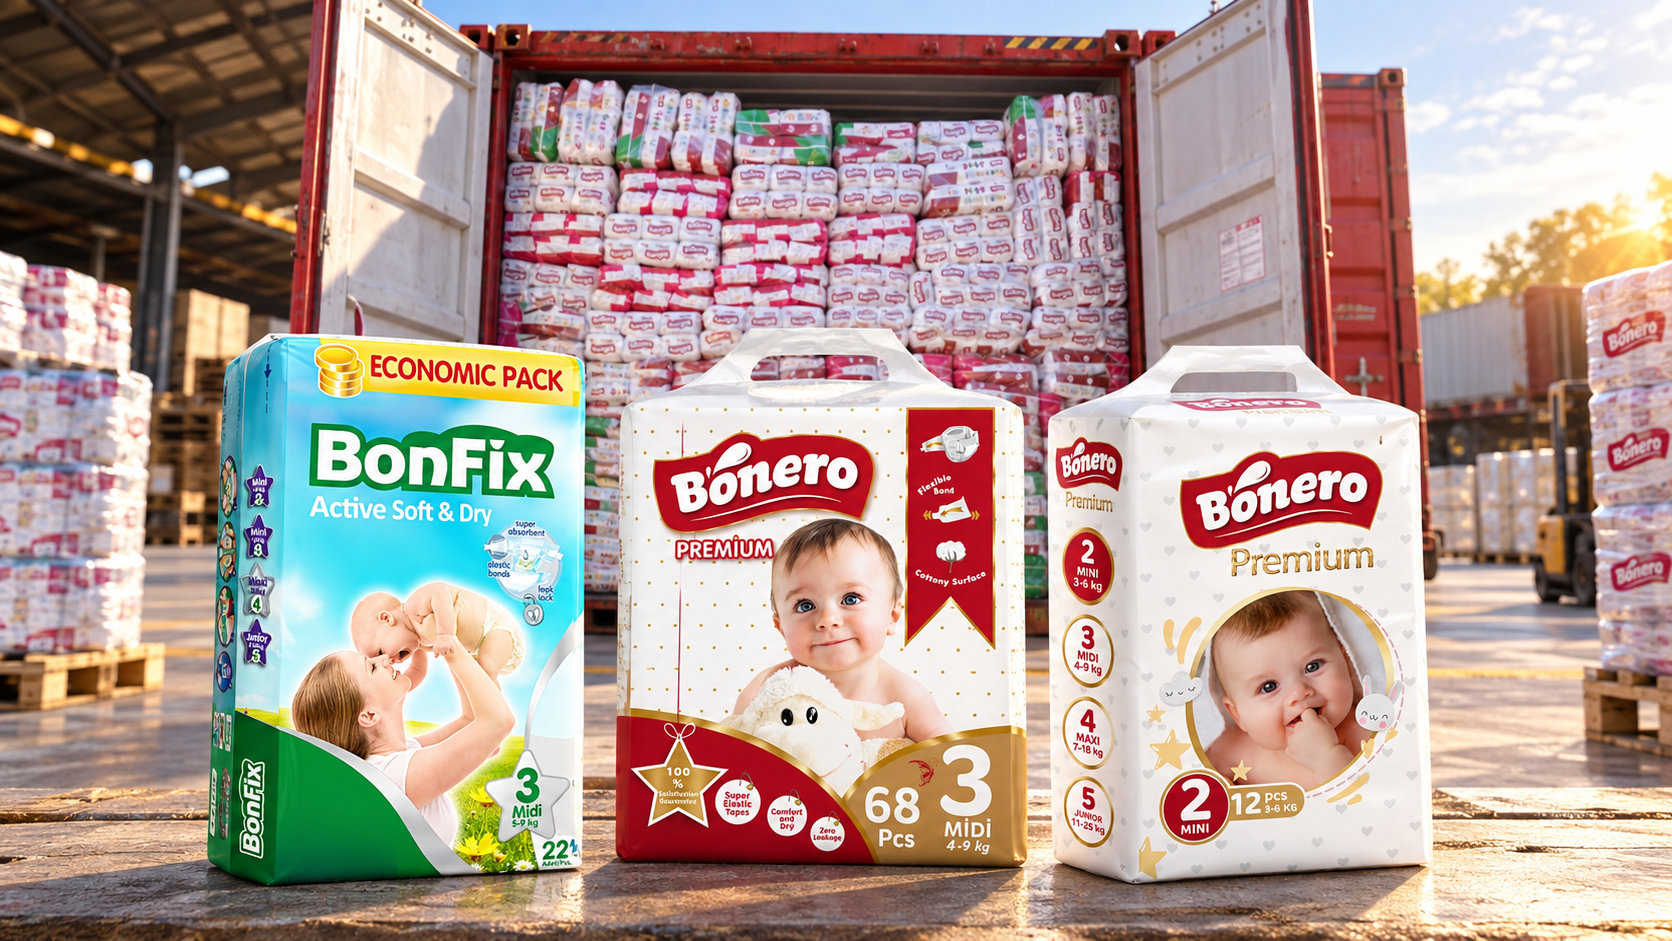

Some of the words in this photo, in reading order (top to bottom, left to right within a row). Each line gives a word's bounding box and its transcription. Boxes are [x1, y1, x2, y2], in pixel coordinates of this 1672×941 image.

[1607, 320, 1657, 352] Bonero
[370, 354, 496, 387] ECONOMIC
[502, 364, 564, 393] PACK
[1612, 436, 1662, 465] Bonero
[316, 428, 548, 494] BonFix
[1065, 491, 1113, 512] Premium
[309, 496, 388, 521] Active
[392, 499, 434, 522] Soft
[438, 503, 455, 522] &
[460, 504, 493, 527] Dry
[508, 528, 545, 537] absorbent
[1081, 539, 1095, 565] 2
[1230, 542, 1375, 577] Premium
[1077, 566, 1099, 579] MINI
[1073, 577, 1089, 589] 3-6
[1091, 579, 1102, 593] kg
[253, 597, 261, 612] 4
[1081, 625, 1095, 650] 3
[1077, 650, 1099, 663] MIDI
[1074, 661, 1090, 672] 4-9
[1091, 664, 1102, 677] kg
[1080, 708, 1096, 733] 4
[1076, 732, 1100, 746] MAXI
[1073, 742, 1091, 754] 7-18
[1092, 746, 1103, 759] kg
[667, 767, 690, 777] 100
[939, 744, 992, 817] 3
[516, 767, 540, 804] 3
[672, 778, 684, 789] %
[724, 791, 750, 801] Super
[1082, 786, 1096, 810] 5
[1180, 779, 1212, 822] 2
[1231, 792, 1262, 815] 12
[243, 762, 262, 854] BonFix
[512, 803, 542, 819] Midi
[770, 808, 803, 816] Comfort
[864, 786, 920, 825] 68
[527, 819, 539, 828] kg
[1074, 809, 1103, 824] JUNIOR
[779, 823, 795, 831] Dry
[819, 826, 836, 835] Zero
[1094, 824, 1105, 836] kg
[1180, 822, 1210, 836] MINI
[878, 828, 916, 848] Pcs
[542, 839, 569, 860] 22
[946, 839, 971, 851] 4-9
[974, 839, 990, 855] kg
